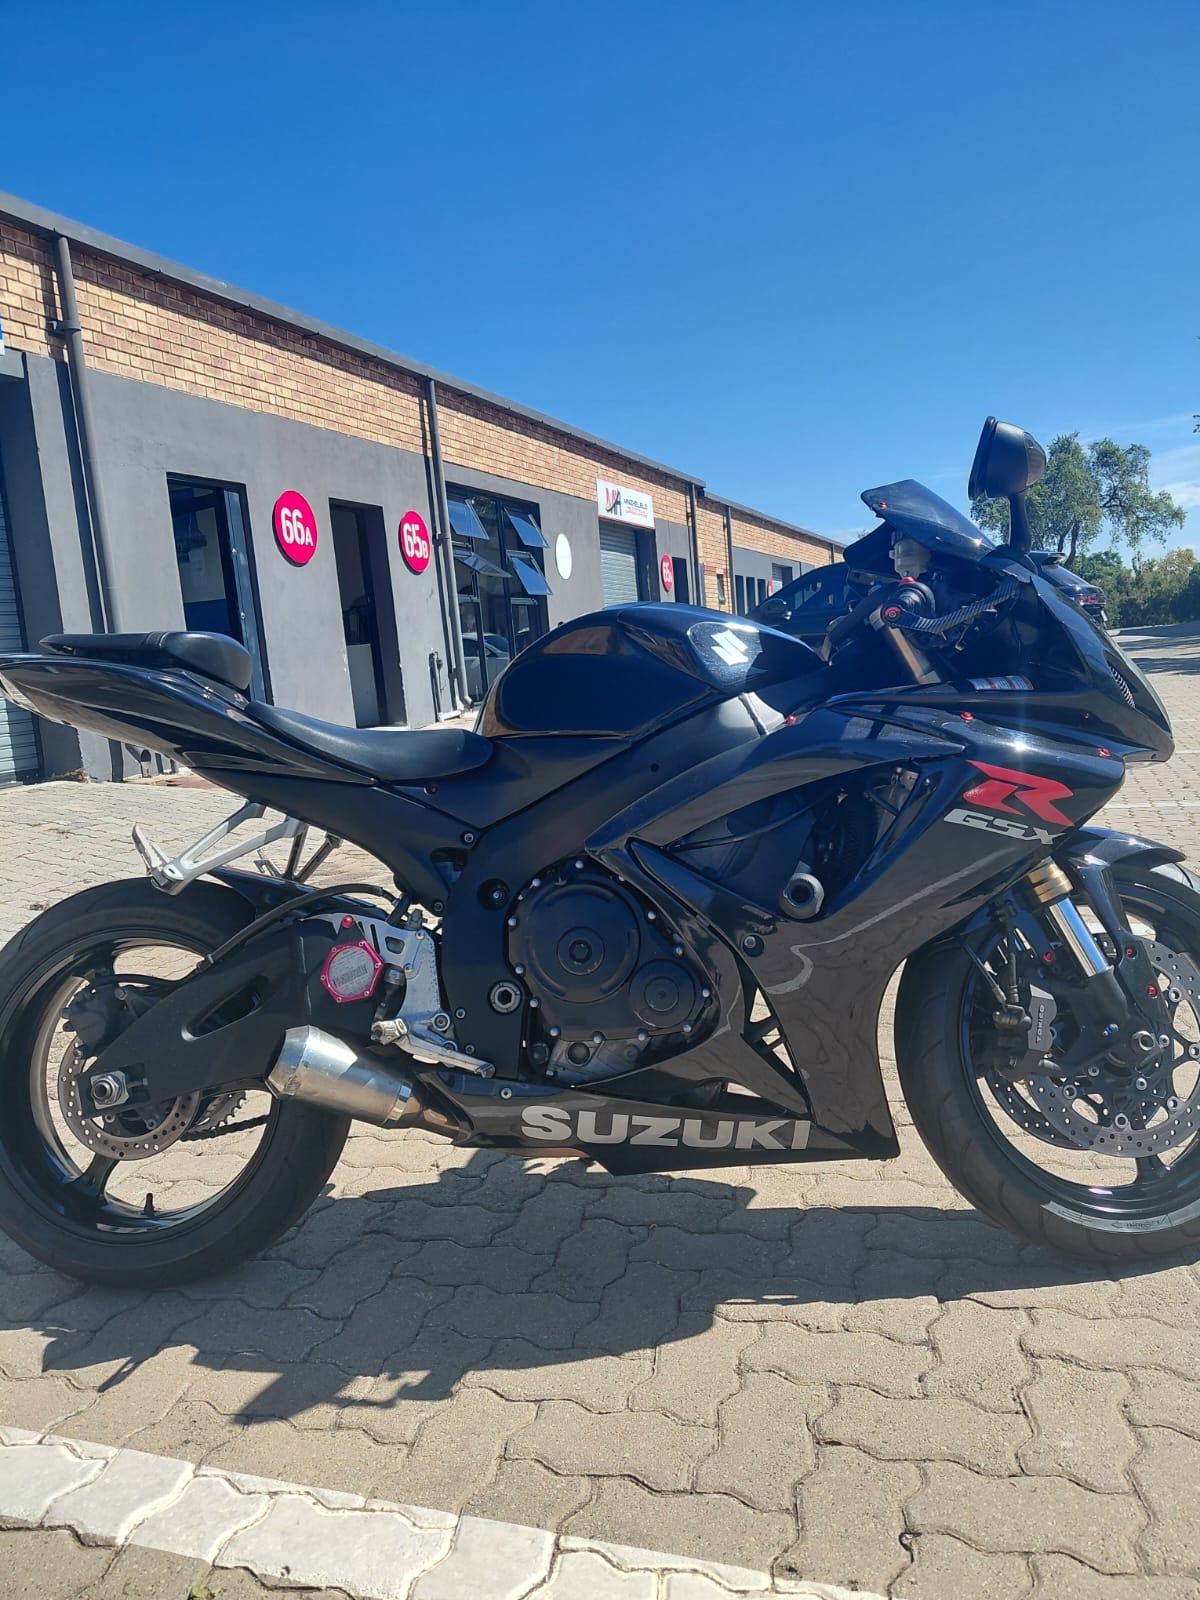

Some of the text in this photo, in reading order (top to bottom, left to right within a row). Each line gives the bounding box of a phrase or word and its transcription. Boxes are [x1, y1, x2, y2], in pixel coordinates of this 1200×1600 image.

[280, 507, 314, 547] 66A
[403, 522, 429, 559] 65B
[962, 759, 1075, 827] R
[943, 808, 1067, 845] GSX
[521, 1105, 811, 1150] SUZUKI
